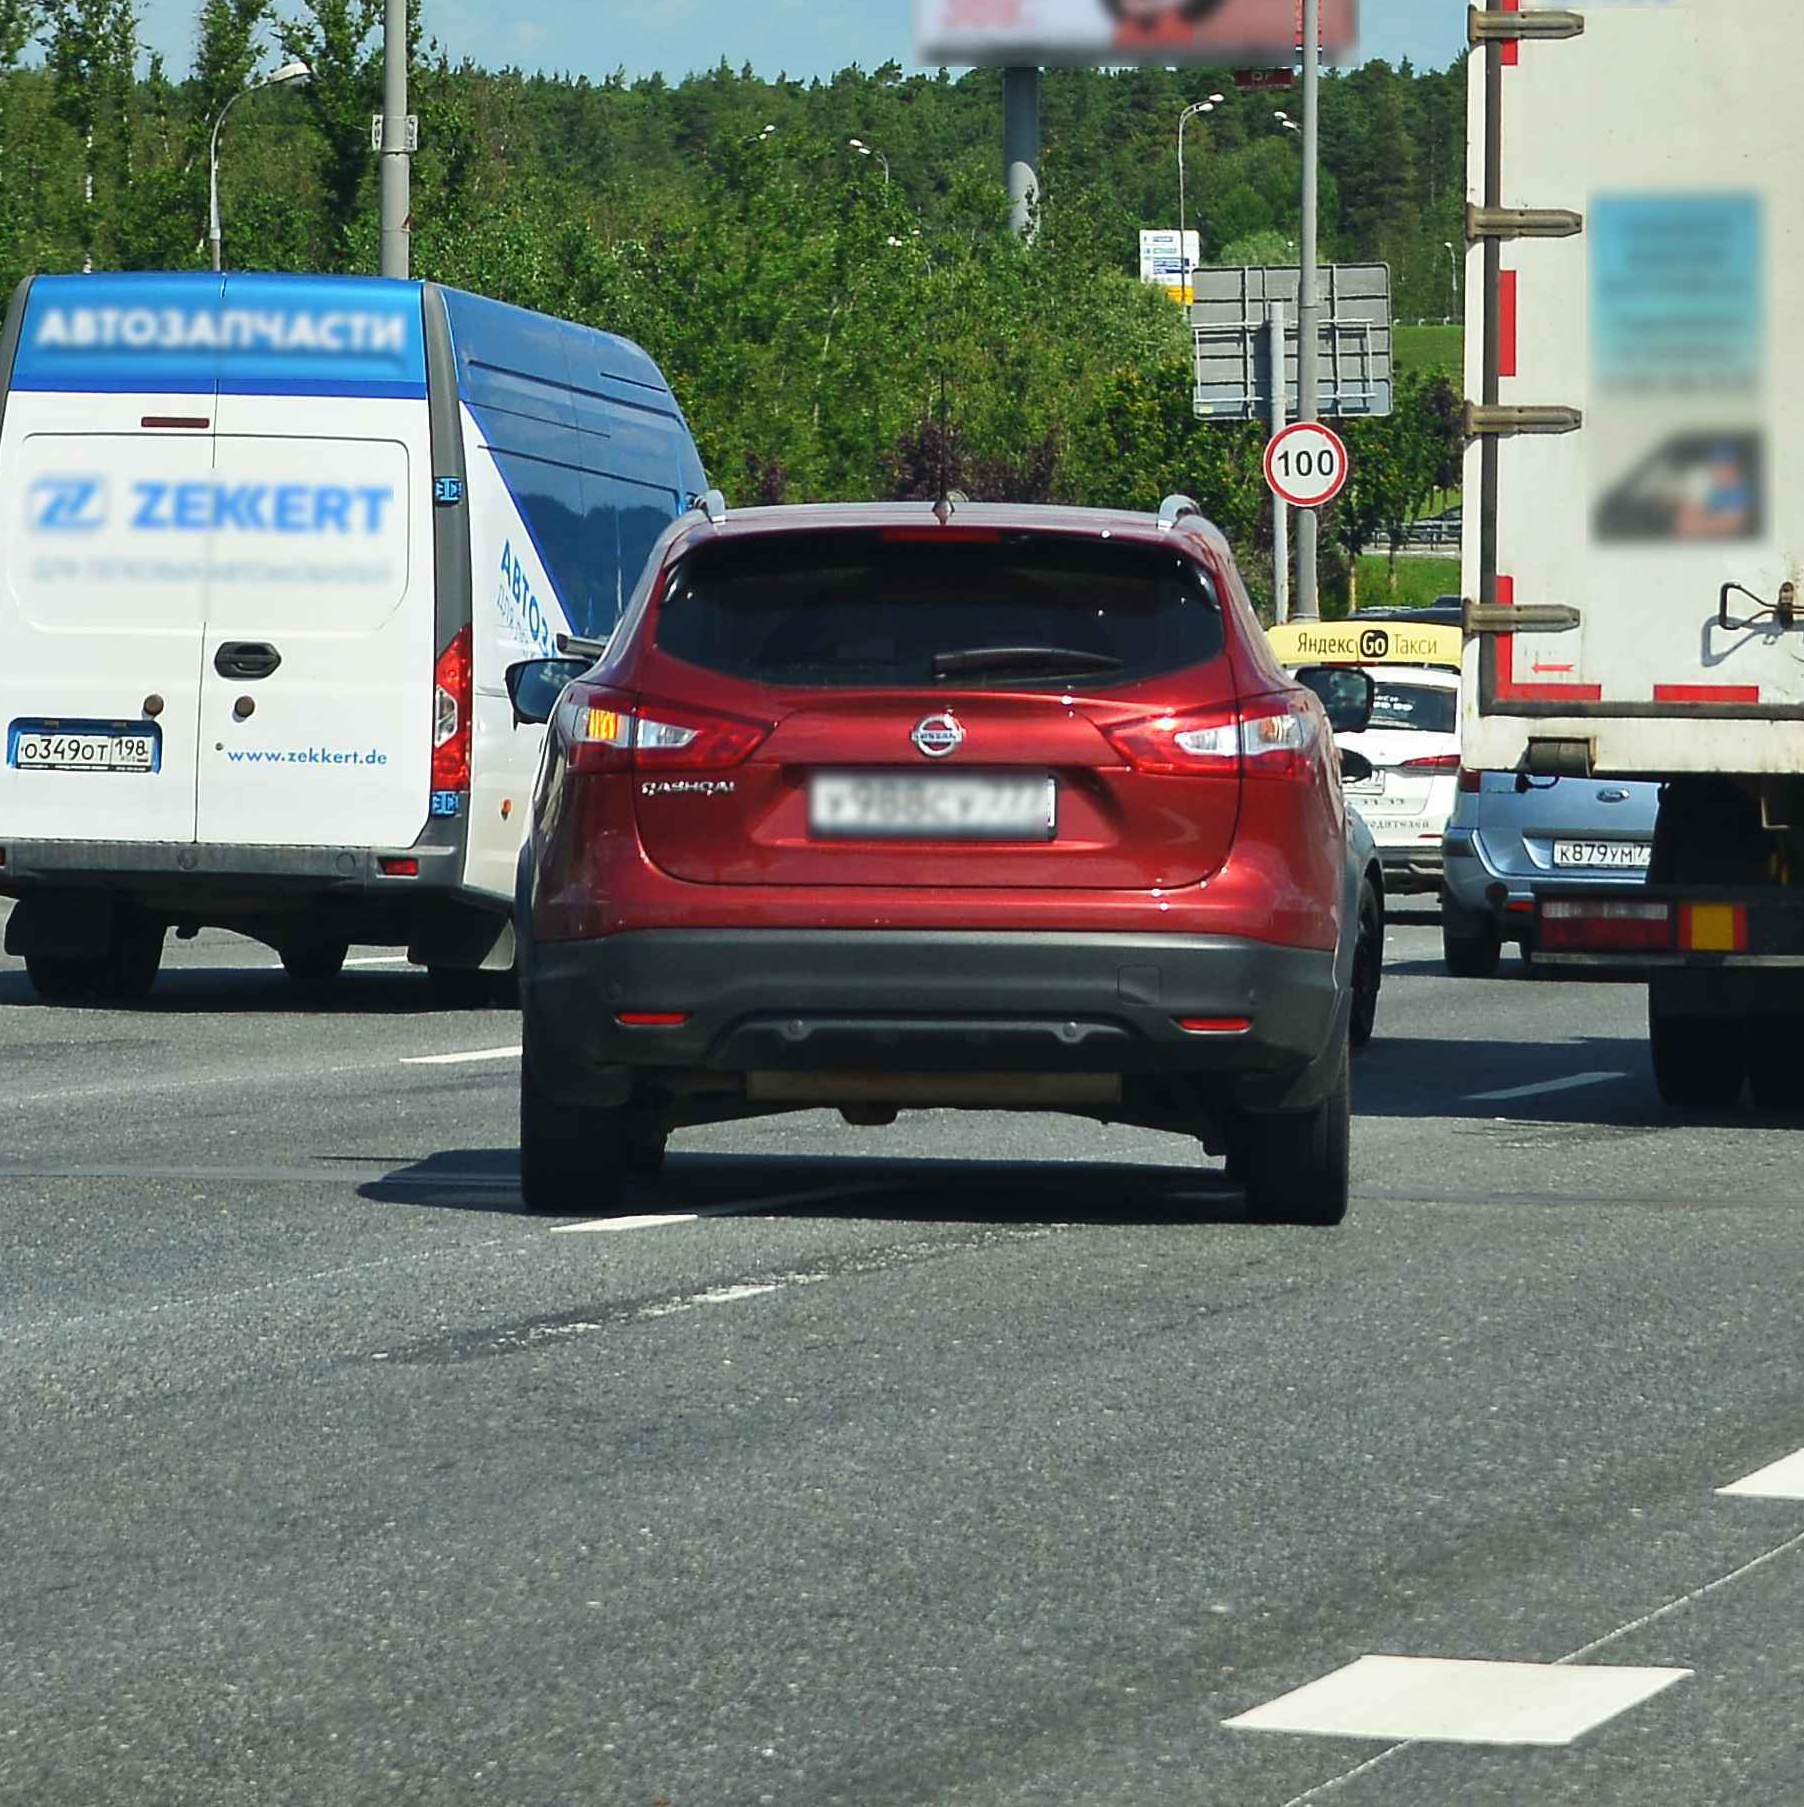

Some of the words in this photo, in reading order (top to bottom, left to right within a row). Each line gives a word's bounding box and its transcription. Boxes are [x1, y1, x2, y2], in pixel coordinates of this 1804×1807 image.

[1277, 449, 1335, 477] 100
[1297, 632, 1355, 655] Яндекс
[1362, 632, 1387, 655] Go
[1393, 634, 1438, 655] Такси
[24, 738, 109, 762] О349ОТ
[114, 739, 146, 756] 198
[227, 747, 388, 765] www.zekkert.de
[641, 780, 736, 796] QASHQAI
[1560, 843, 1633, 863] К879УМ
